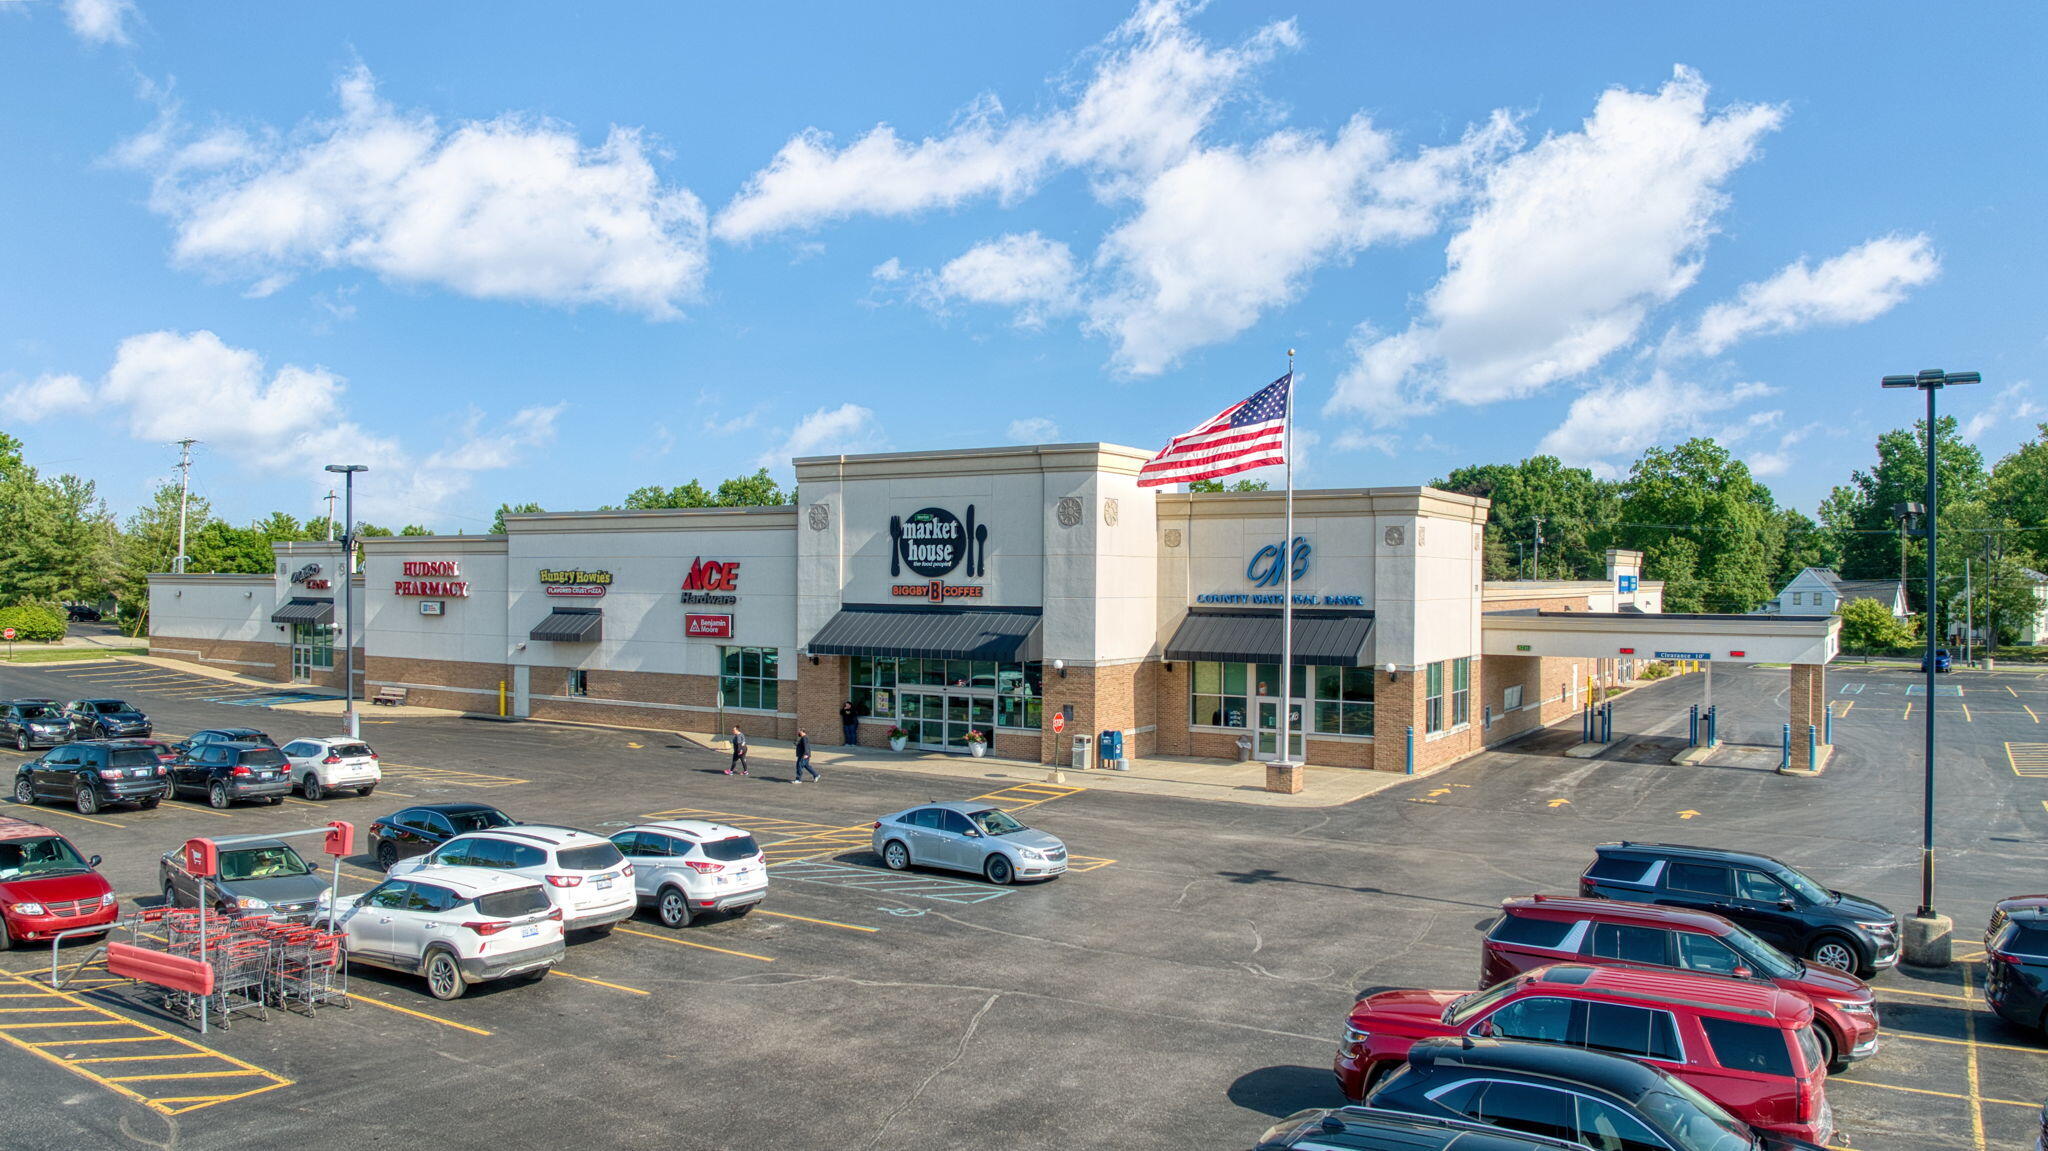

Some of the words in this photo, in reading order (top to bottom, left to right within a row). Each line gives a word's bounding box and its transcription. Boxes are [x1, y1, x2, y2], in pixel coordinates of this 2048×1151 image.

[902, 517, 958, 539] market
[907, 539, 953, 561] house
[402, 561, 459, 577] HUDSON
[540, 569, 576, 584] Hungry
[681, 556, 740, 591] ACE
[394, 581, 468, 597] PHARMACY
[943, 585, 984, 597] COFFEE
[681, 592, 737, 605] Hardware
[1197, 594, 1249, 605] COUNTY
[1324, 595, 1364, 606] BANK
[700, 619, 726, 627] Benjamin
